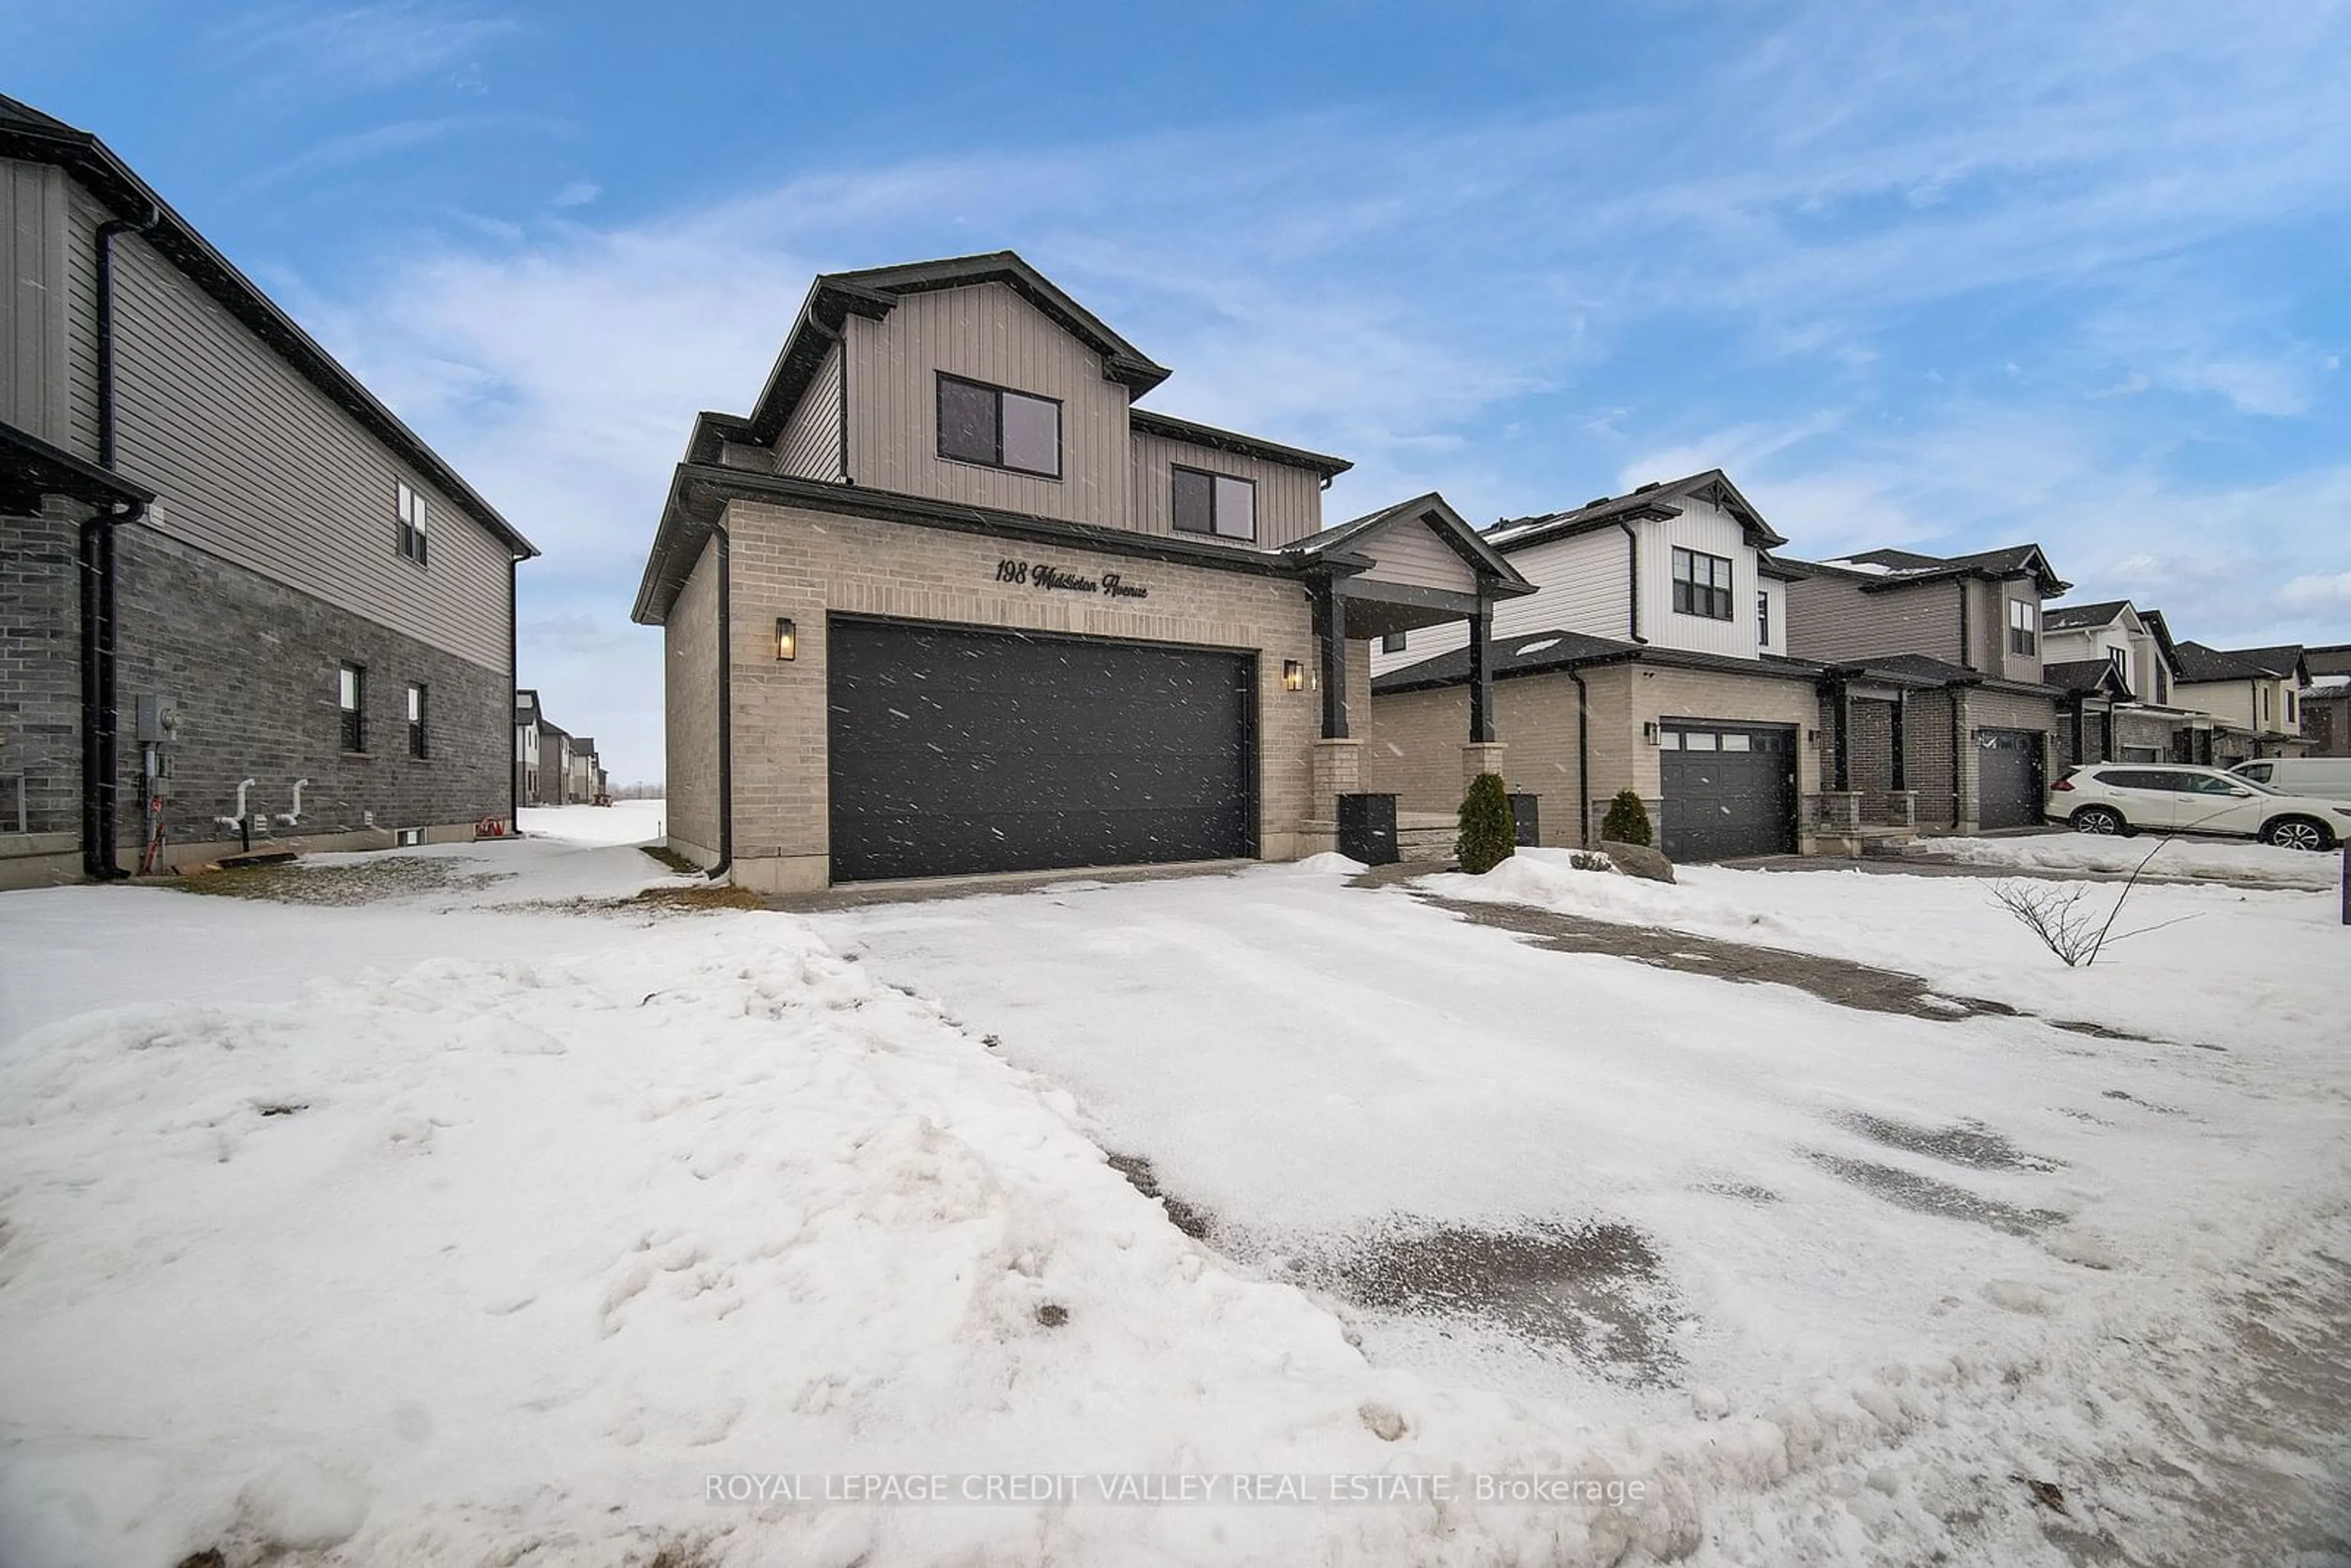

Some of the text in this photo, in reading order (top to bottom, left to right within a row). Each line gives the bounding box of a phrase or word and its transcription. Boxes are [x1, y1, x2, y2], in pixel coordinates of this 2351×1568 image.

[996, 559, 1149, 598] 198 Middleton Avenue
